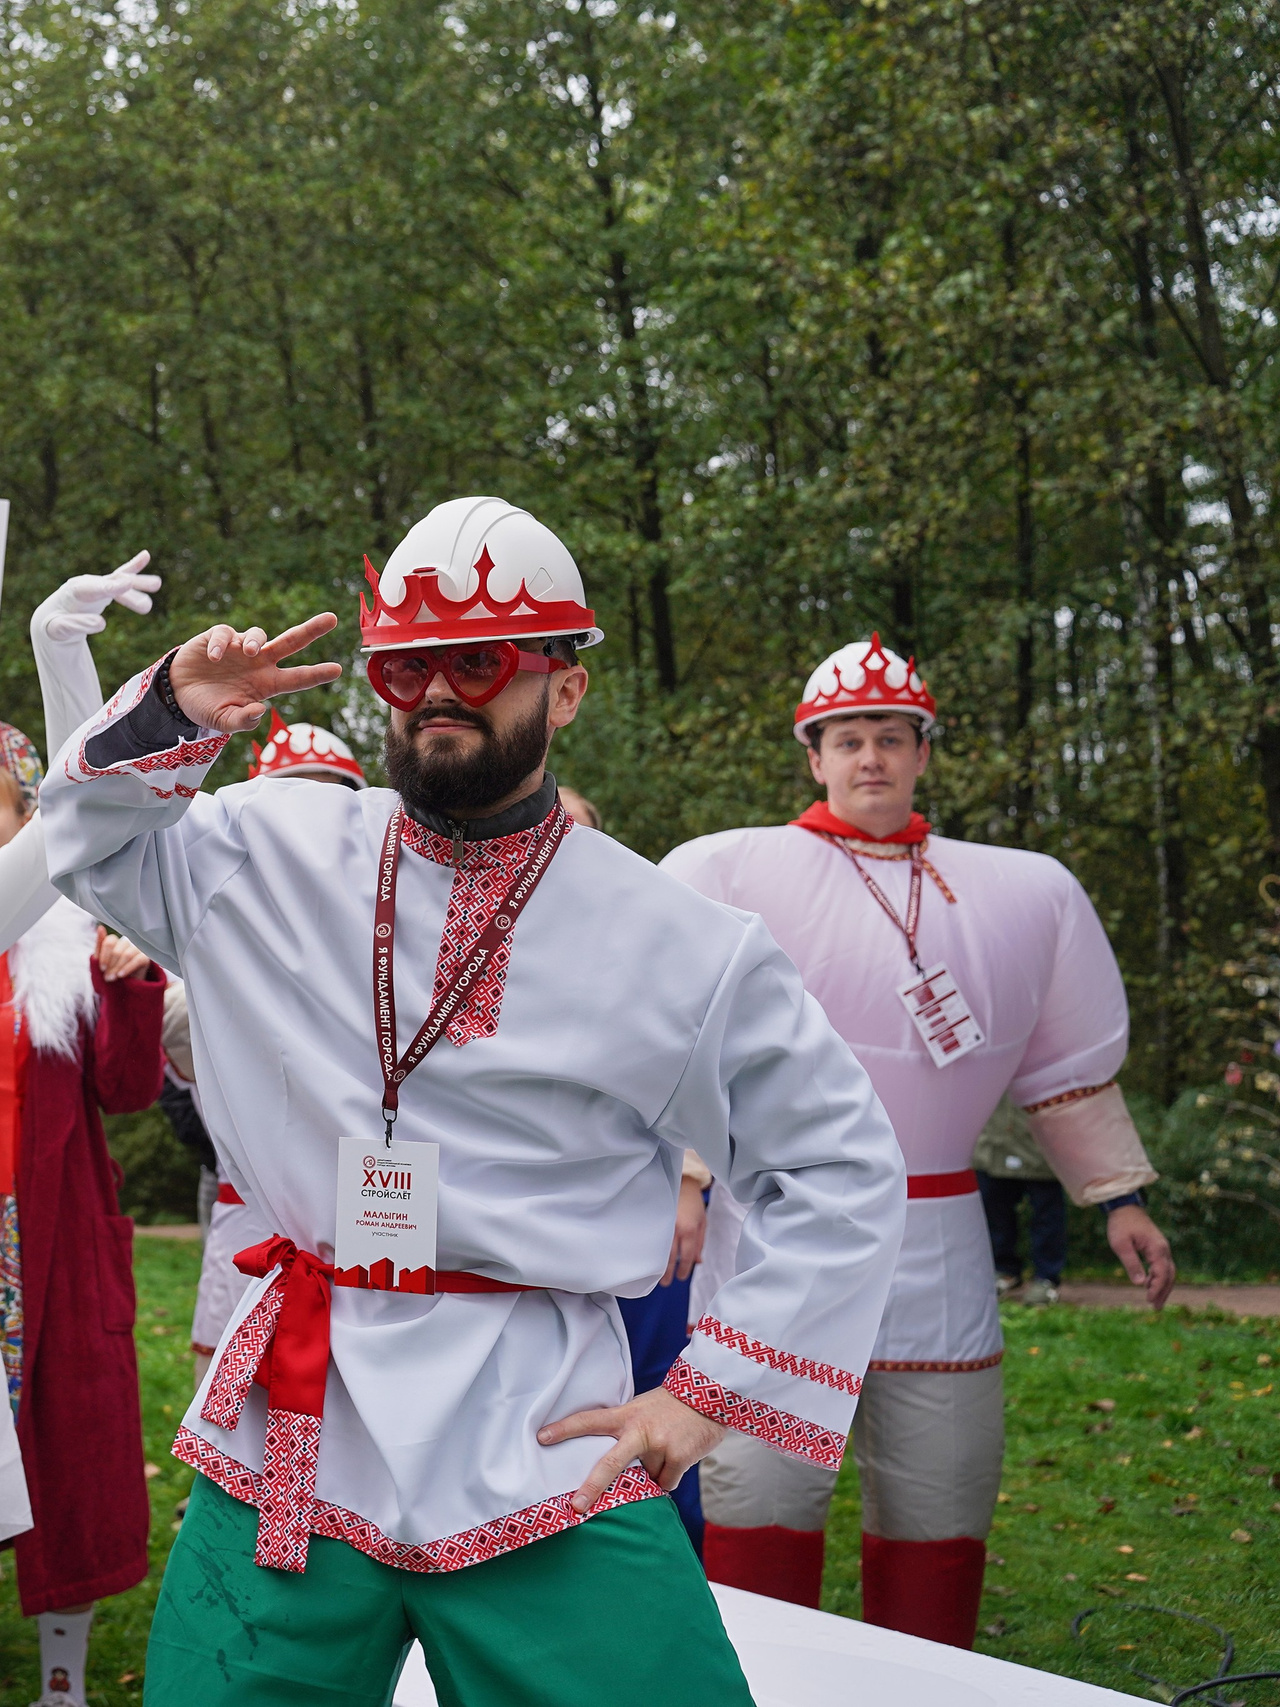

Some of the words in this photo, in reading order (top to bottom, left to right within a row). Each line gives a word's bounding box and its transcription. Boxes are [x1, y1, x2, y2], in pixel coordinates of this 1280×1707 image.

[380, 857, 394, 902] ГОРОДА
[508, 899, 519, 909] Я
[514, 839, 555, 900] ФУНДАМЕНТ
[377, 956, 391, 1029] ФУНДАМЕНТ
[414, 991, 460, 1056] ФУНДАМЕНТ
[454, 948, 489, 992] ГОРОДА
[361, 1188, 412, 1200] СТРОЙСЛЁТ
[362, 1169, 412, 1190] XVIII
[355, 1219, 380, 1227] РОМАН
[380, 1222, 417, 1230] АНДРЕЕВИЧ
[363, 1210, 408, 1221] МАЛЫГИН
